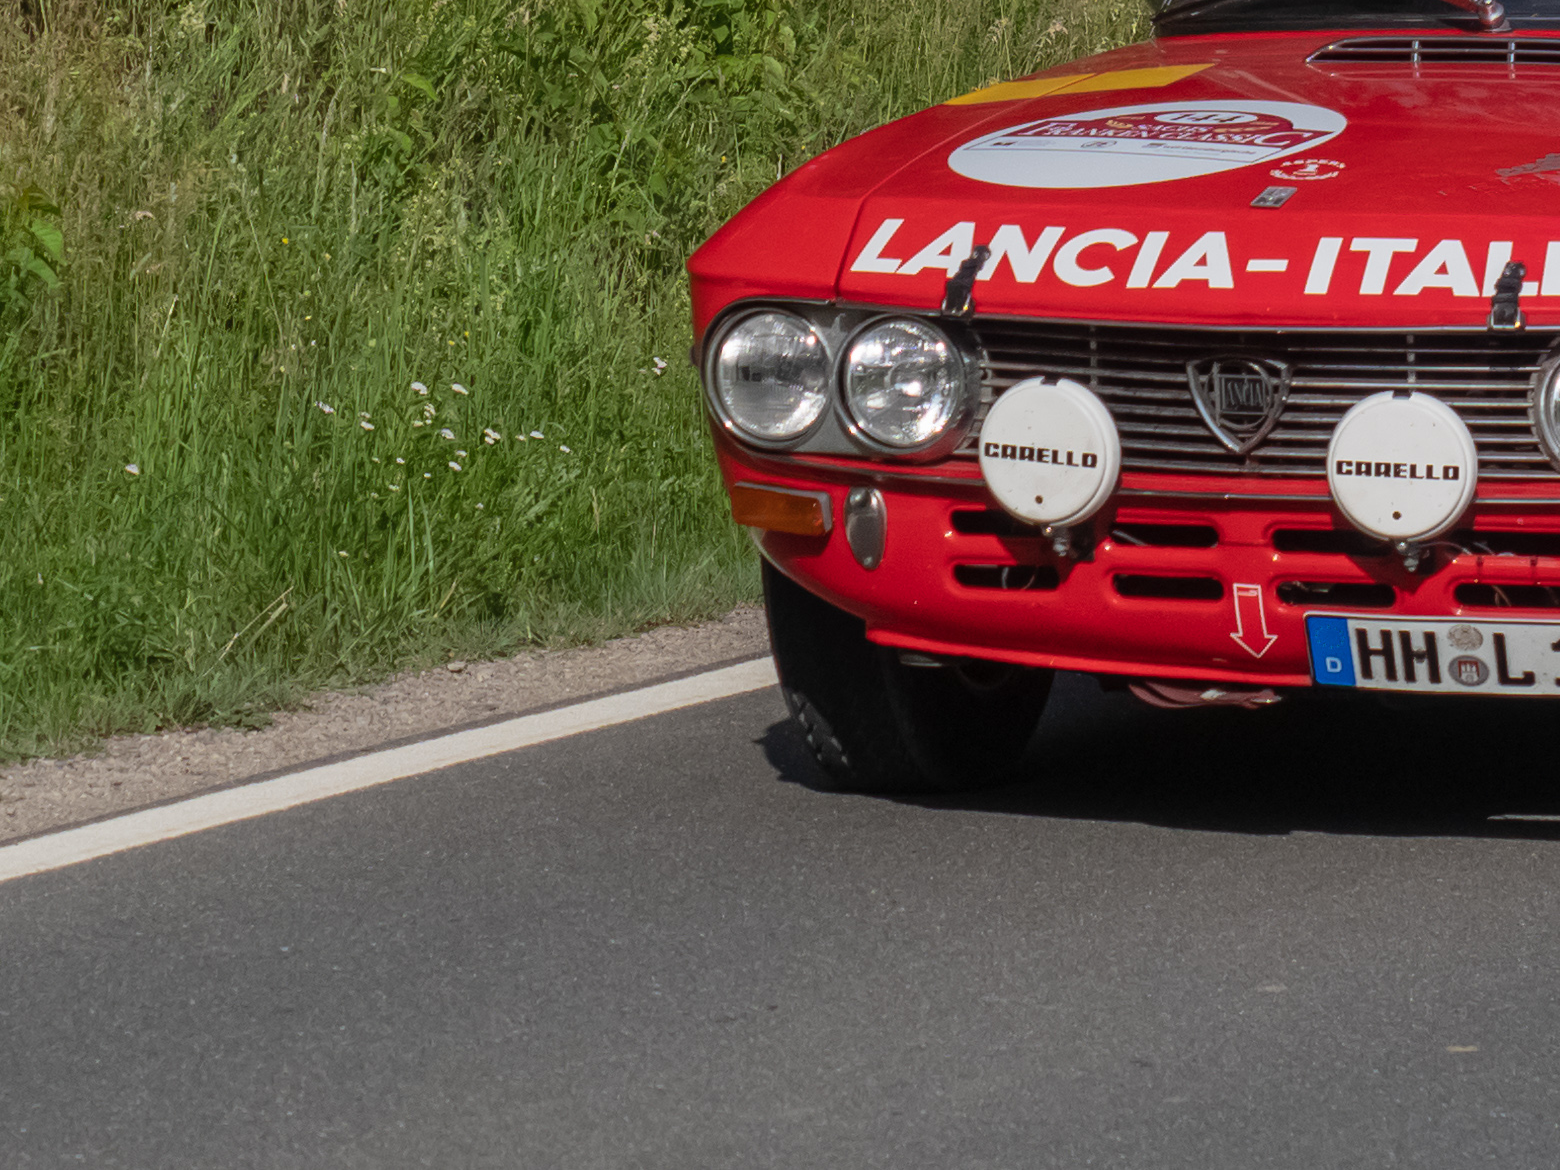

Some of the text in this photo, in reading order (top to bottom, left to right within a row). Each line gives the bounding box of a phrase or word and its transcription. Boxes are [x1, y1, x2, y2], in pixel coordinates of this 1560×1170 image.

[1169, 112, 1246, 123] 144
[983, 442, 1098, 470] CARELLO
[1335, 459, 1461, 482] CARELLO
[1326, 656, 1342, 673] D
[1355, 627, 1442, 685] HH
[1493, 633, 1535, 687] L
